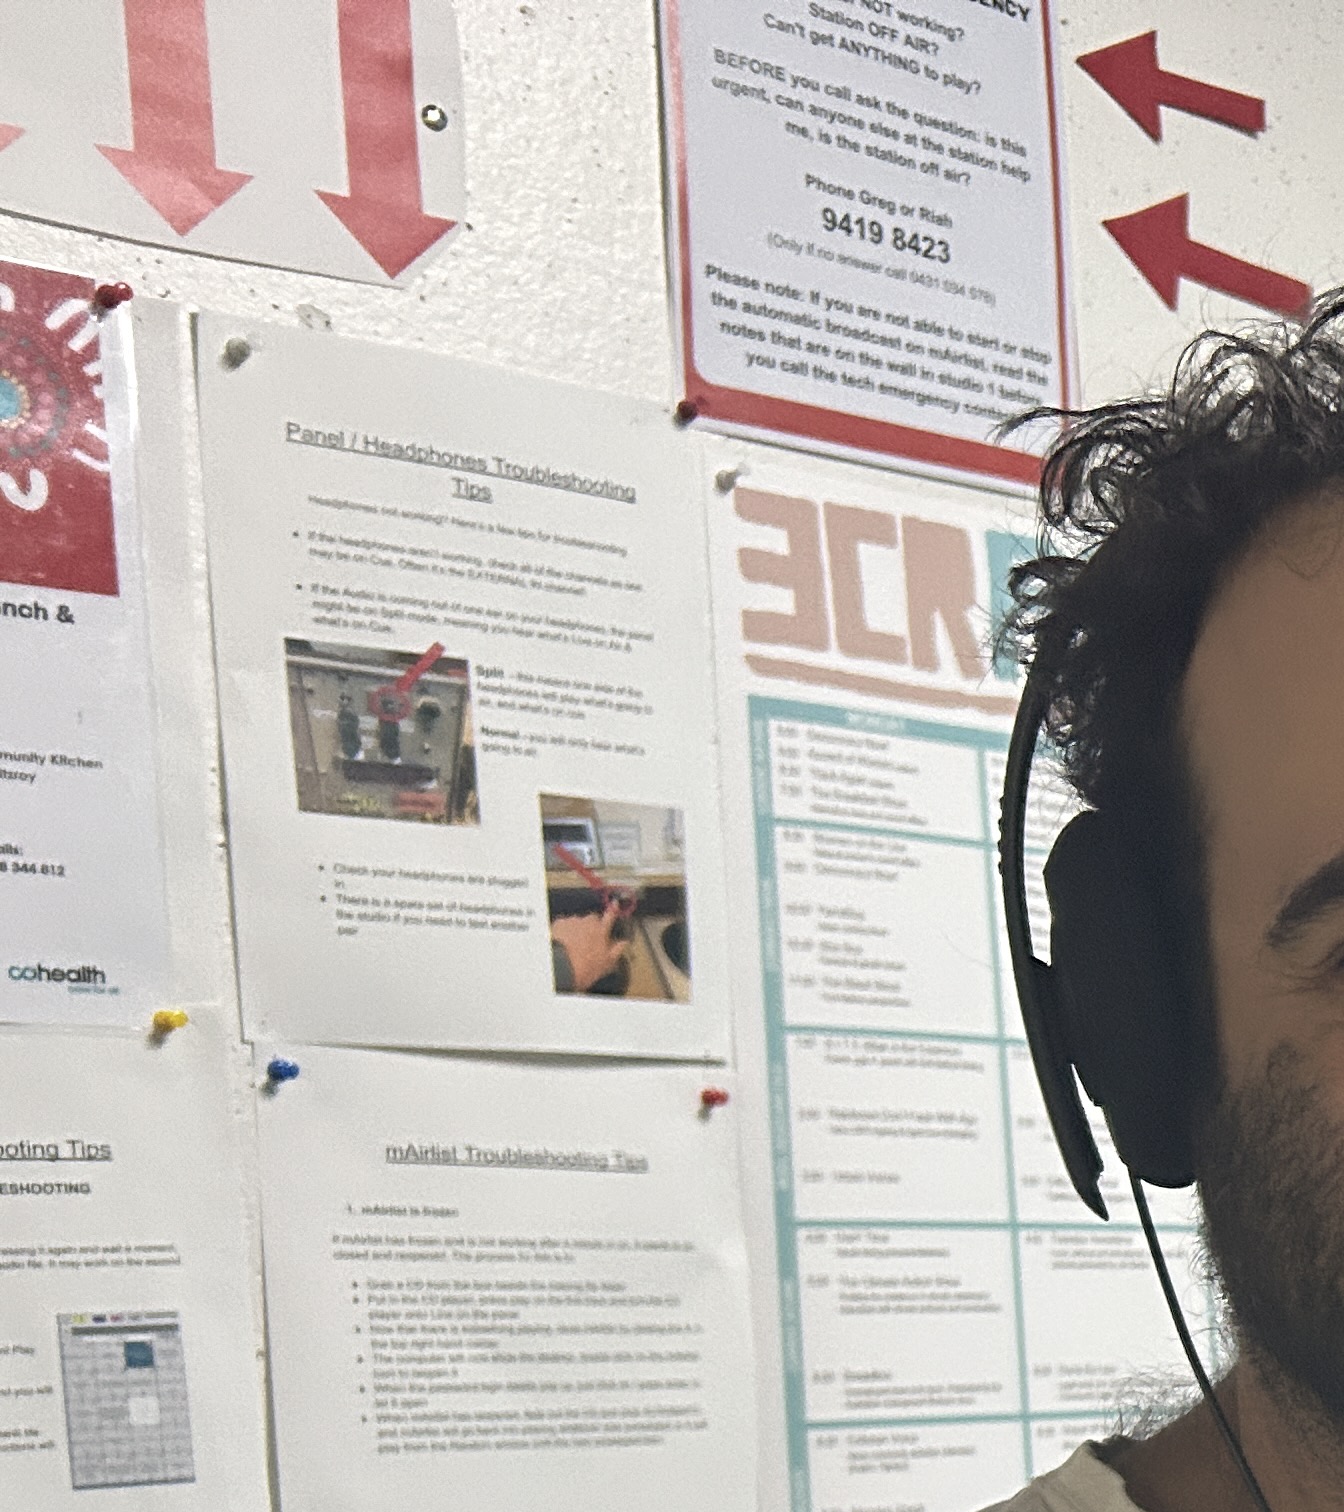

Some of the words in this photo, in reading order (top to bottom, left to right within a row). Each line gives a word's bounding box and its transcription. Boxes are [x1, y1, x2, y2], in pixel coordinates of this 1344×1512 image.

[808, 2, 865, 31] Station
[868, 21, 899, 41] OFF
[903, 33, 939, 56] AIR?
[862, 0, 892, 17] NOT
[897, 10, 965, 42] working?
[764, 13, 804, 38] Can't
[809, 30, 835, 47] get
[838, 36, 920, 74] ANYTHING
[923, 64, 939, 81] to
[942, 73, 982, 95] play?
[712, 76, 771, 104] urgent,
[776, 94, 804, 112] can
[809, 104, 865, 130] anyone
[870, 122, 900, 141] else
[904, 133, 918, 147] at
[922, 136, 944, 155] the
[949, 147, 998, 170] station
[1001, 160, 1031, 184] help
[713, 48, 786, 82] BEFORE
[790, 74, 820, 92] you
[824, 84, 851, 101] call
[856, 94, 882, 111] ask
[886, 101, 910, 120] the
[985, 132, 997, 148] is
[1000, 137, 1027, 158] this
[785, 121, 814, 140] me,
[818, 128, 832, 144] is
[835, 134, 862, 153] the
[865, 145, 916, 169] station
[920, 161, 939, 177] off
[944, 169, 971, 186] air?
[805, 173, 855, 200] Phone
[859, 190, 896, 215] Greg
[900, 205, 915, 217] or
[822, 207, 883, 244] 9419
[893, 227, 951, 264] 8423
[286, 421, 345, 449] Panel
[363, 433, 487, 473] Headphones
[492, 456, 637, 503] Troubleshooting
[452, 476, 493, 502] Tips
[733, 486, 987, 681] 3CR
[0, 600, 48, 621] nch
[56, 604, 75, 625] &
[8, 962, 106, 985] cohealth
[65, 1139, 112, 1161] Tips
[385, 1143, 457, 1164] mAirlist
[463, 1144, 609, 1171] Troubleshooting
